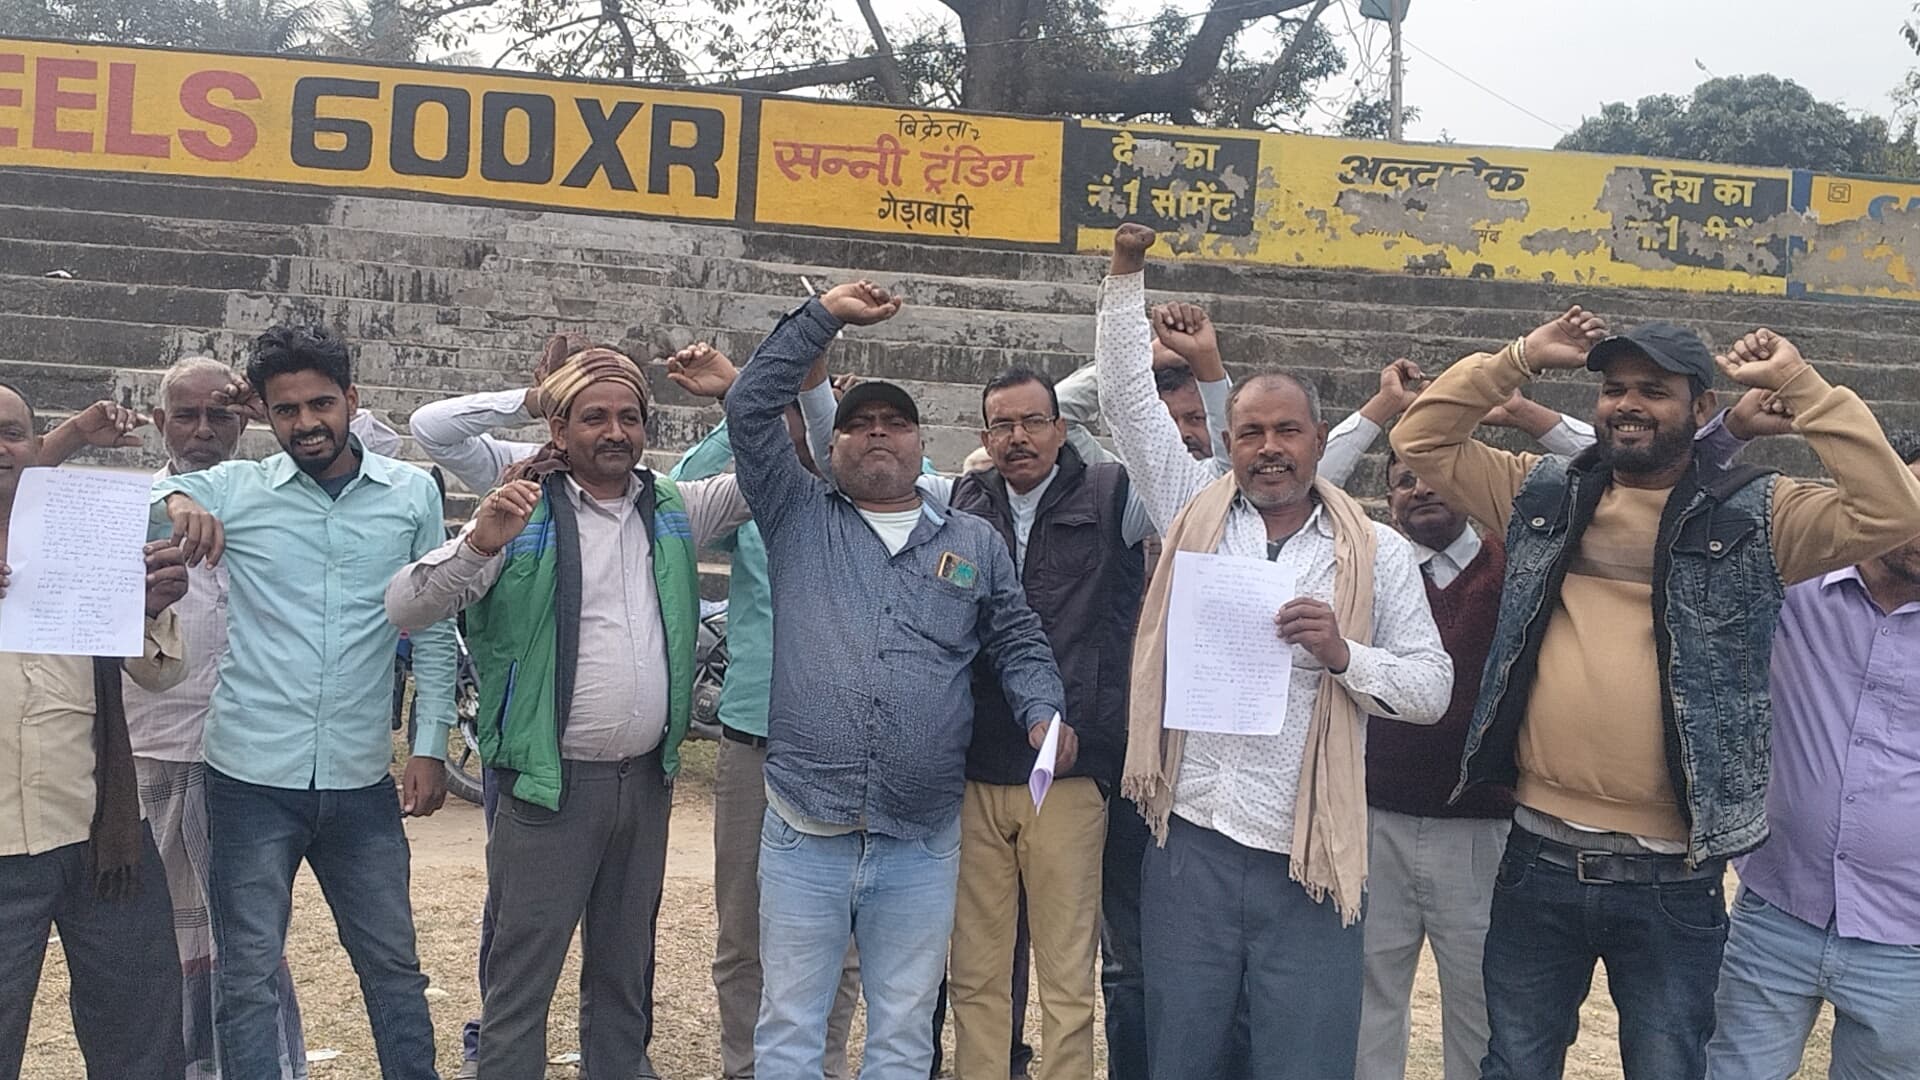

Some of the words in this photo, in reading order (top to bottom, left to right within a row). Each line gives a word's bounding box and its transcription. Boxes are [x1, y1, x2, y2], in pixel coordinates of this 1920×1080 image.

[290, 76, 726, 199] 600XR
[773, 133, 911, 187] सन्नी
[1174, 142, 1222, 171] का
[1651, 168, 1705, 204] देश
[1713, 178, 1757, 207] का
